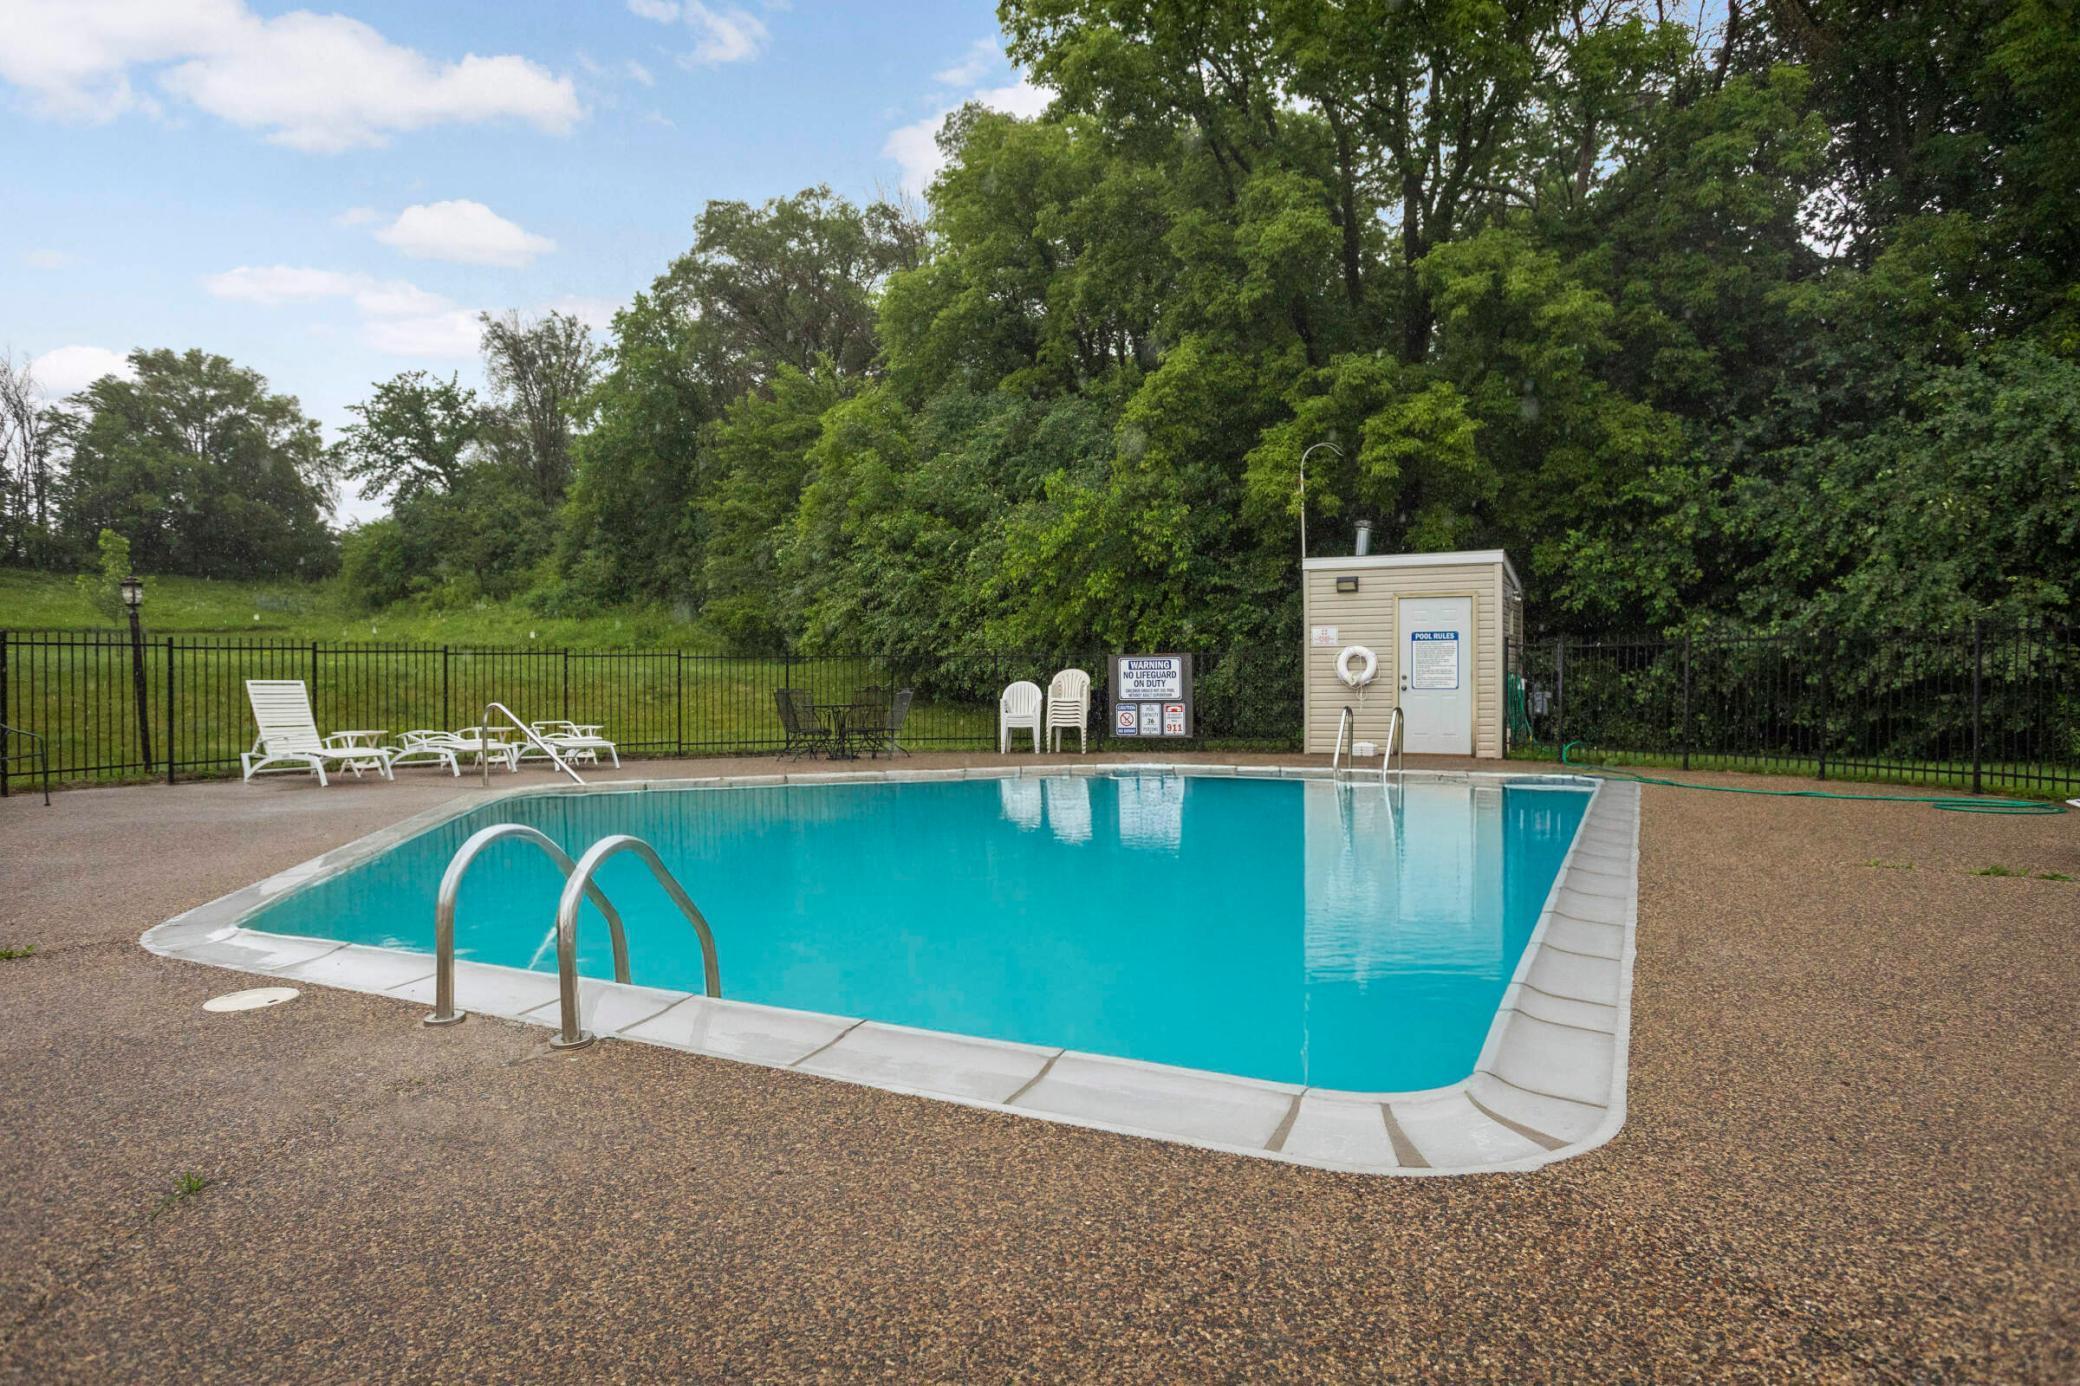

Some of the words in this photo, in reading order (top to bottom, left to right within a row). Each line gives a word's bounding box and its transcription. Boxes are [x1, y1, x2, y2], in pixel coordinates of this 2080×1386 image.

[1131, 661, 1169, 669] WARNING
[1123, 671, 1134, 679] NO
[1135, 671, 1177, 679] LIFEGUARD
[1167, 724, 1182, 732] 911
